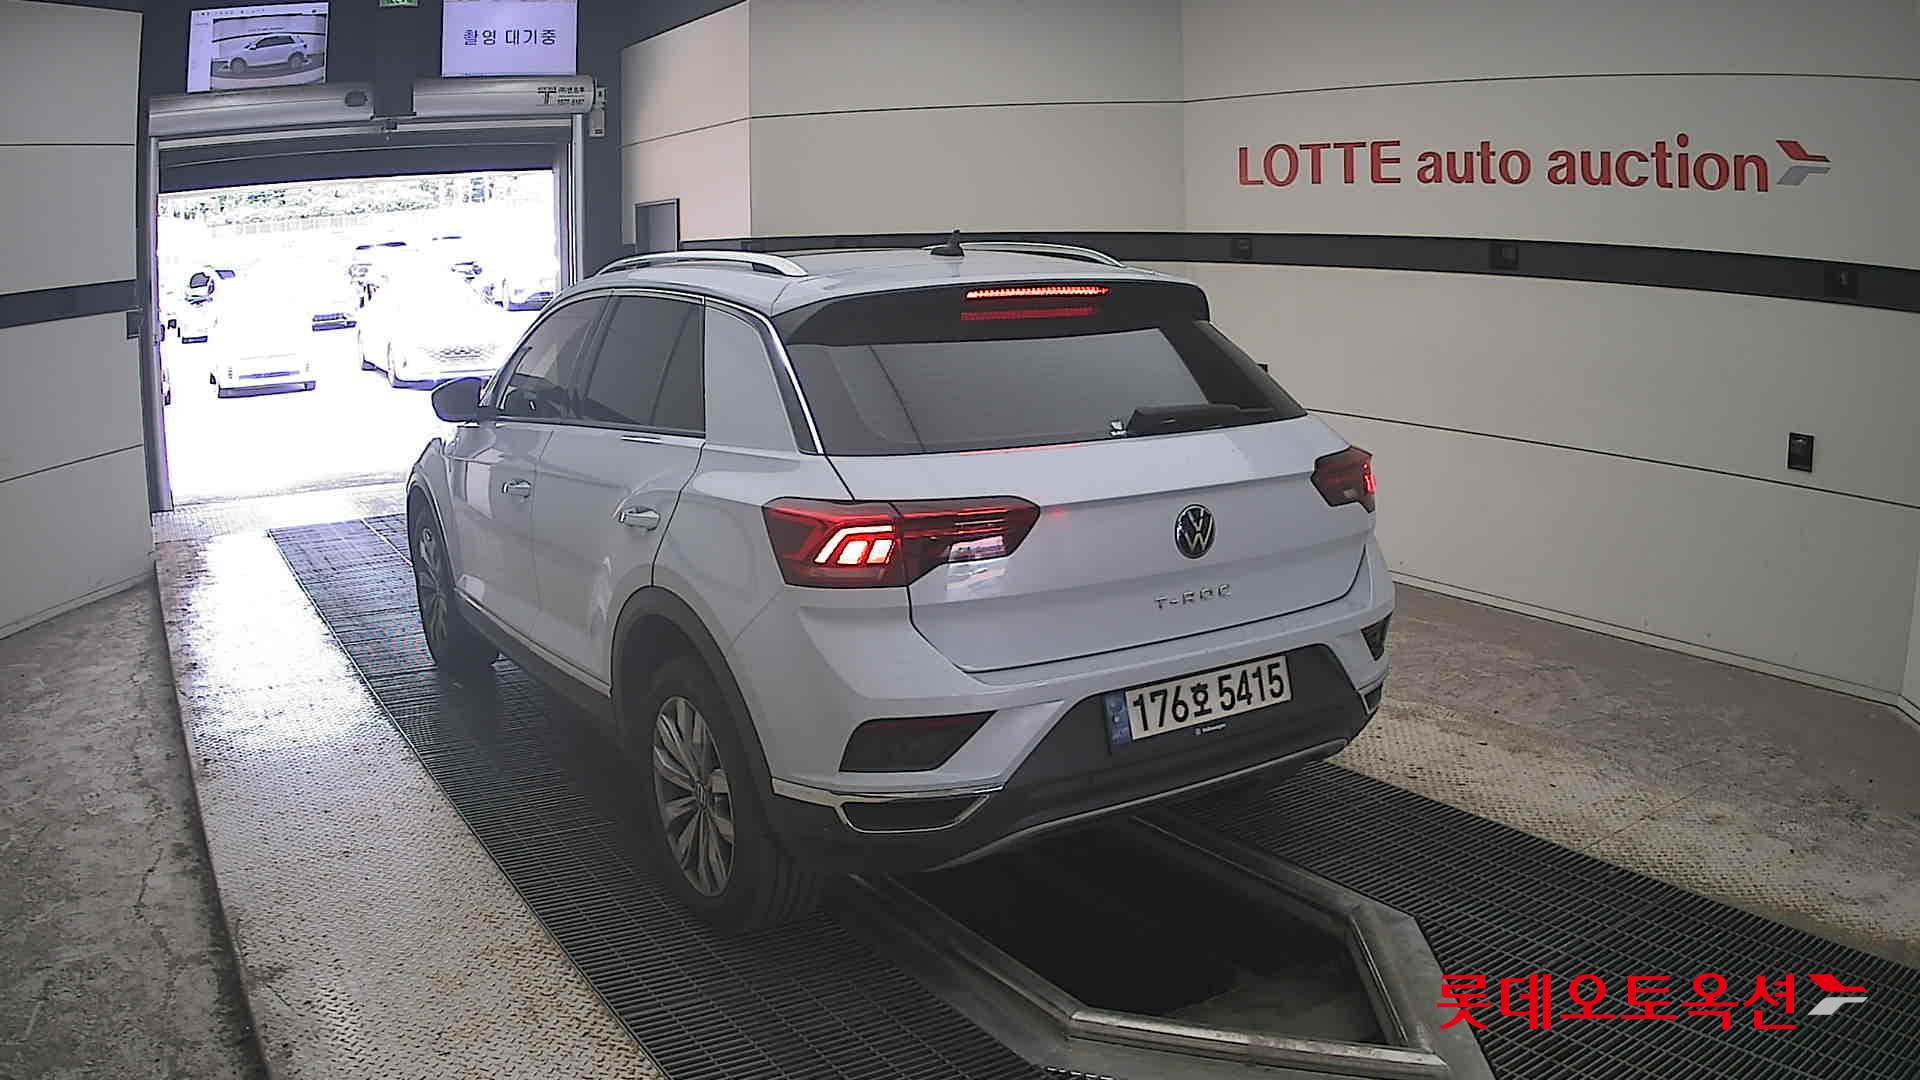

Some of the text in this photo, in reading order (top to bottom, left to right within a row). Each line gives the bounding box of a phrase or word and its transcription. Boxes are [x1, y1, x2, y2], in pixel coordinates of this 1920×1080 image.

[464, 29, 555, 46] 촬영 대기중
[1238, 133, 1769, 192] LOTTE auto auction
[1217, 661, 1285, 711] 5415
